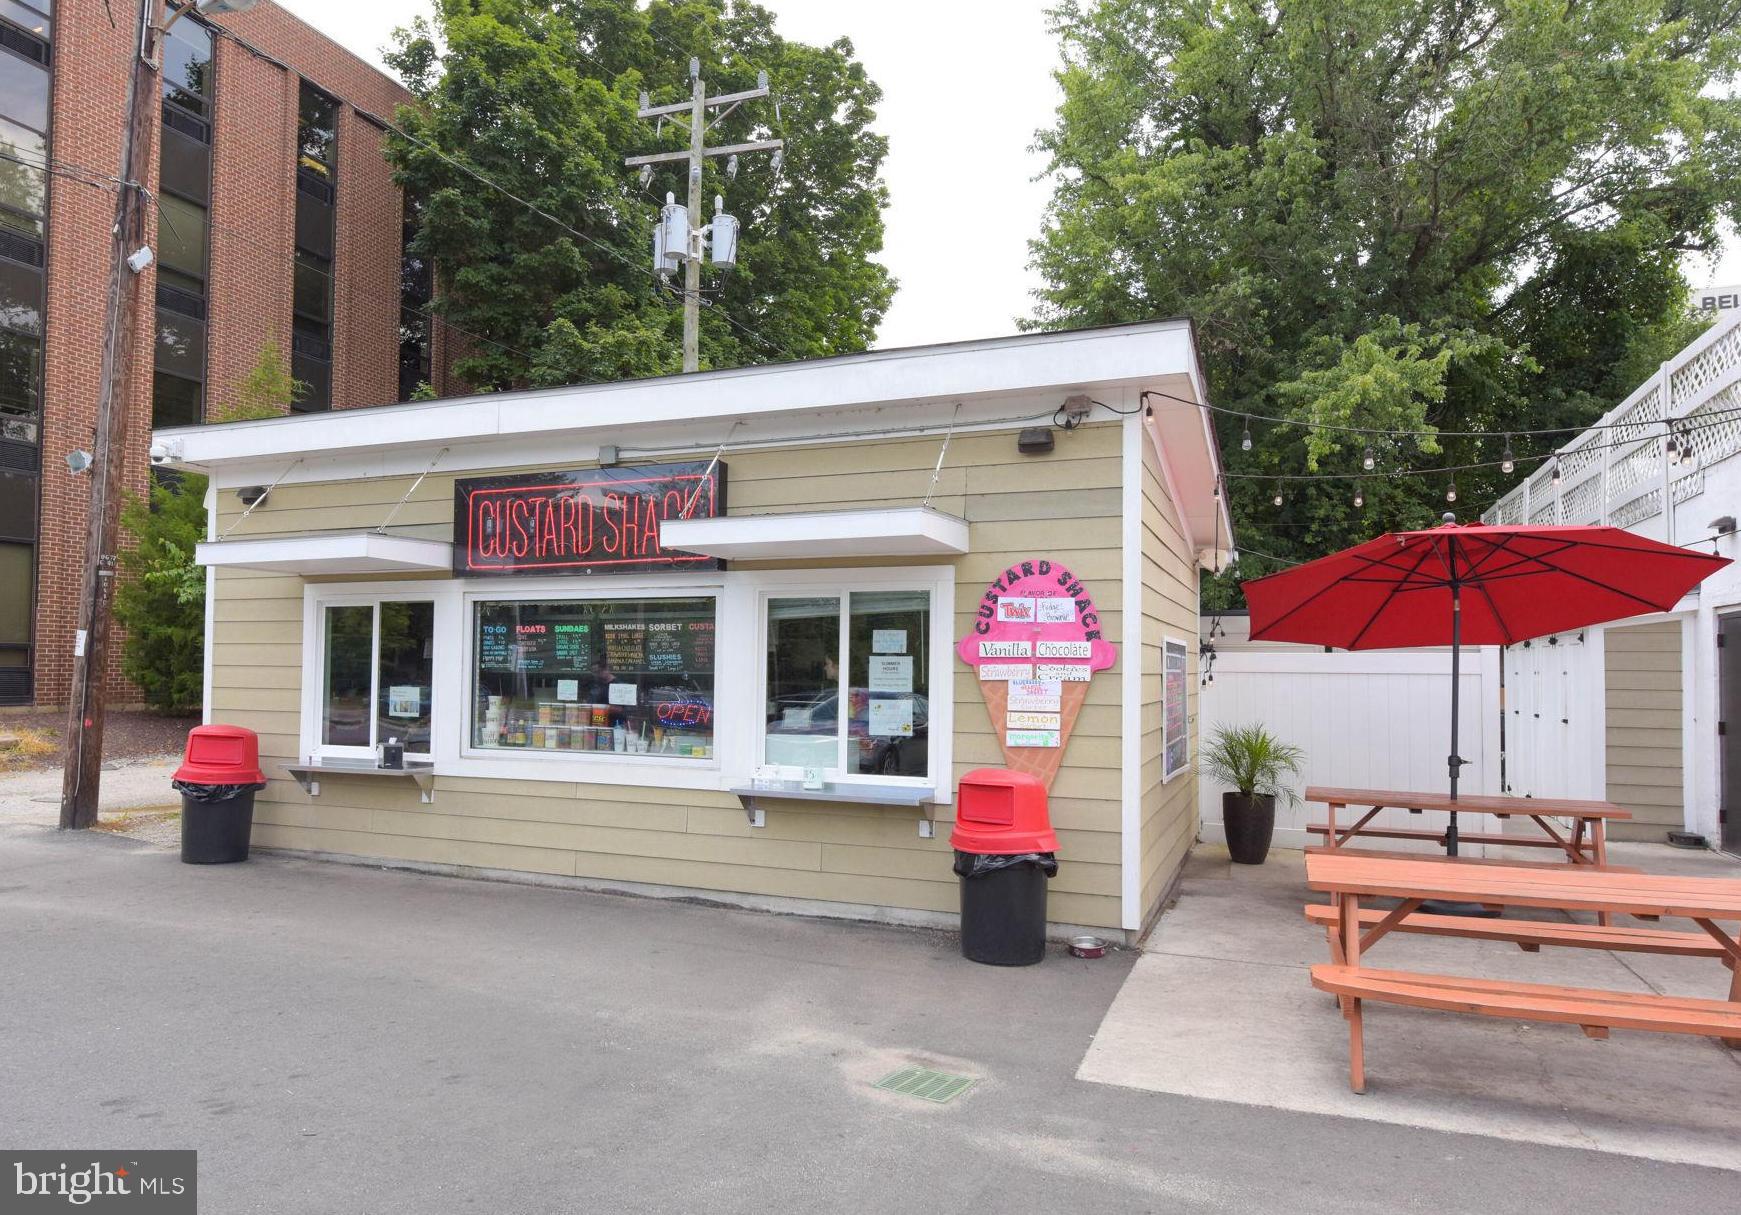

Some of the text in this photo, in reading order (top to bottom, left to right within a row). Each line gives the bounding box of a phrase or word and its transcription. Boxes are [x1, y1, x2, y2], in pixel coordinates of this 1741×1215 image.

[479, 496, 594, 558] CUSTARD
[975, 560, 1102, 642] CUSTARD SHACK
[516, 624, 546, 633] FLOATS
[554, 625, 589, 633] SUNDAES
[604, 623, 645, 631] MILKSHAKES
[648, 623, 683, 631] SORBET
[981, 643, 1028, 657] Vanilla
[1038, 642, 1088, 656] Chocolate
[657, 703, 711, 725] OPEN
[1008, 712, 1058, 724] Lemon
